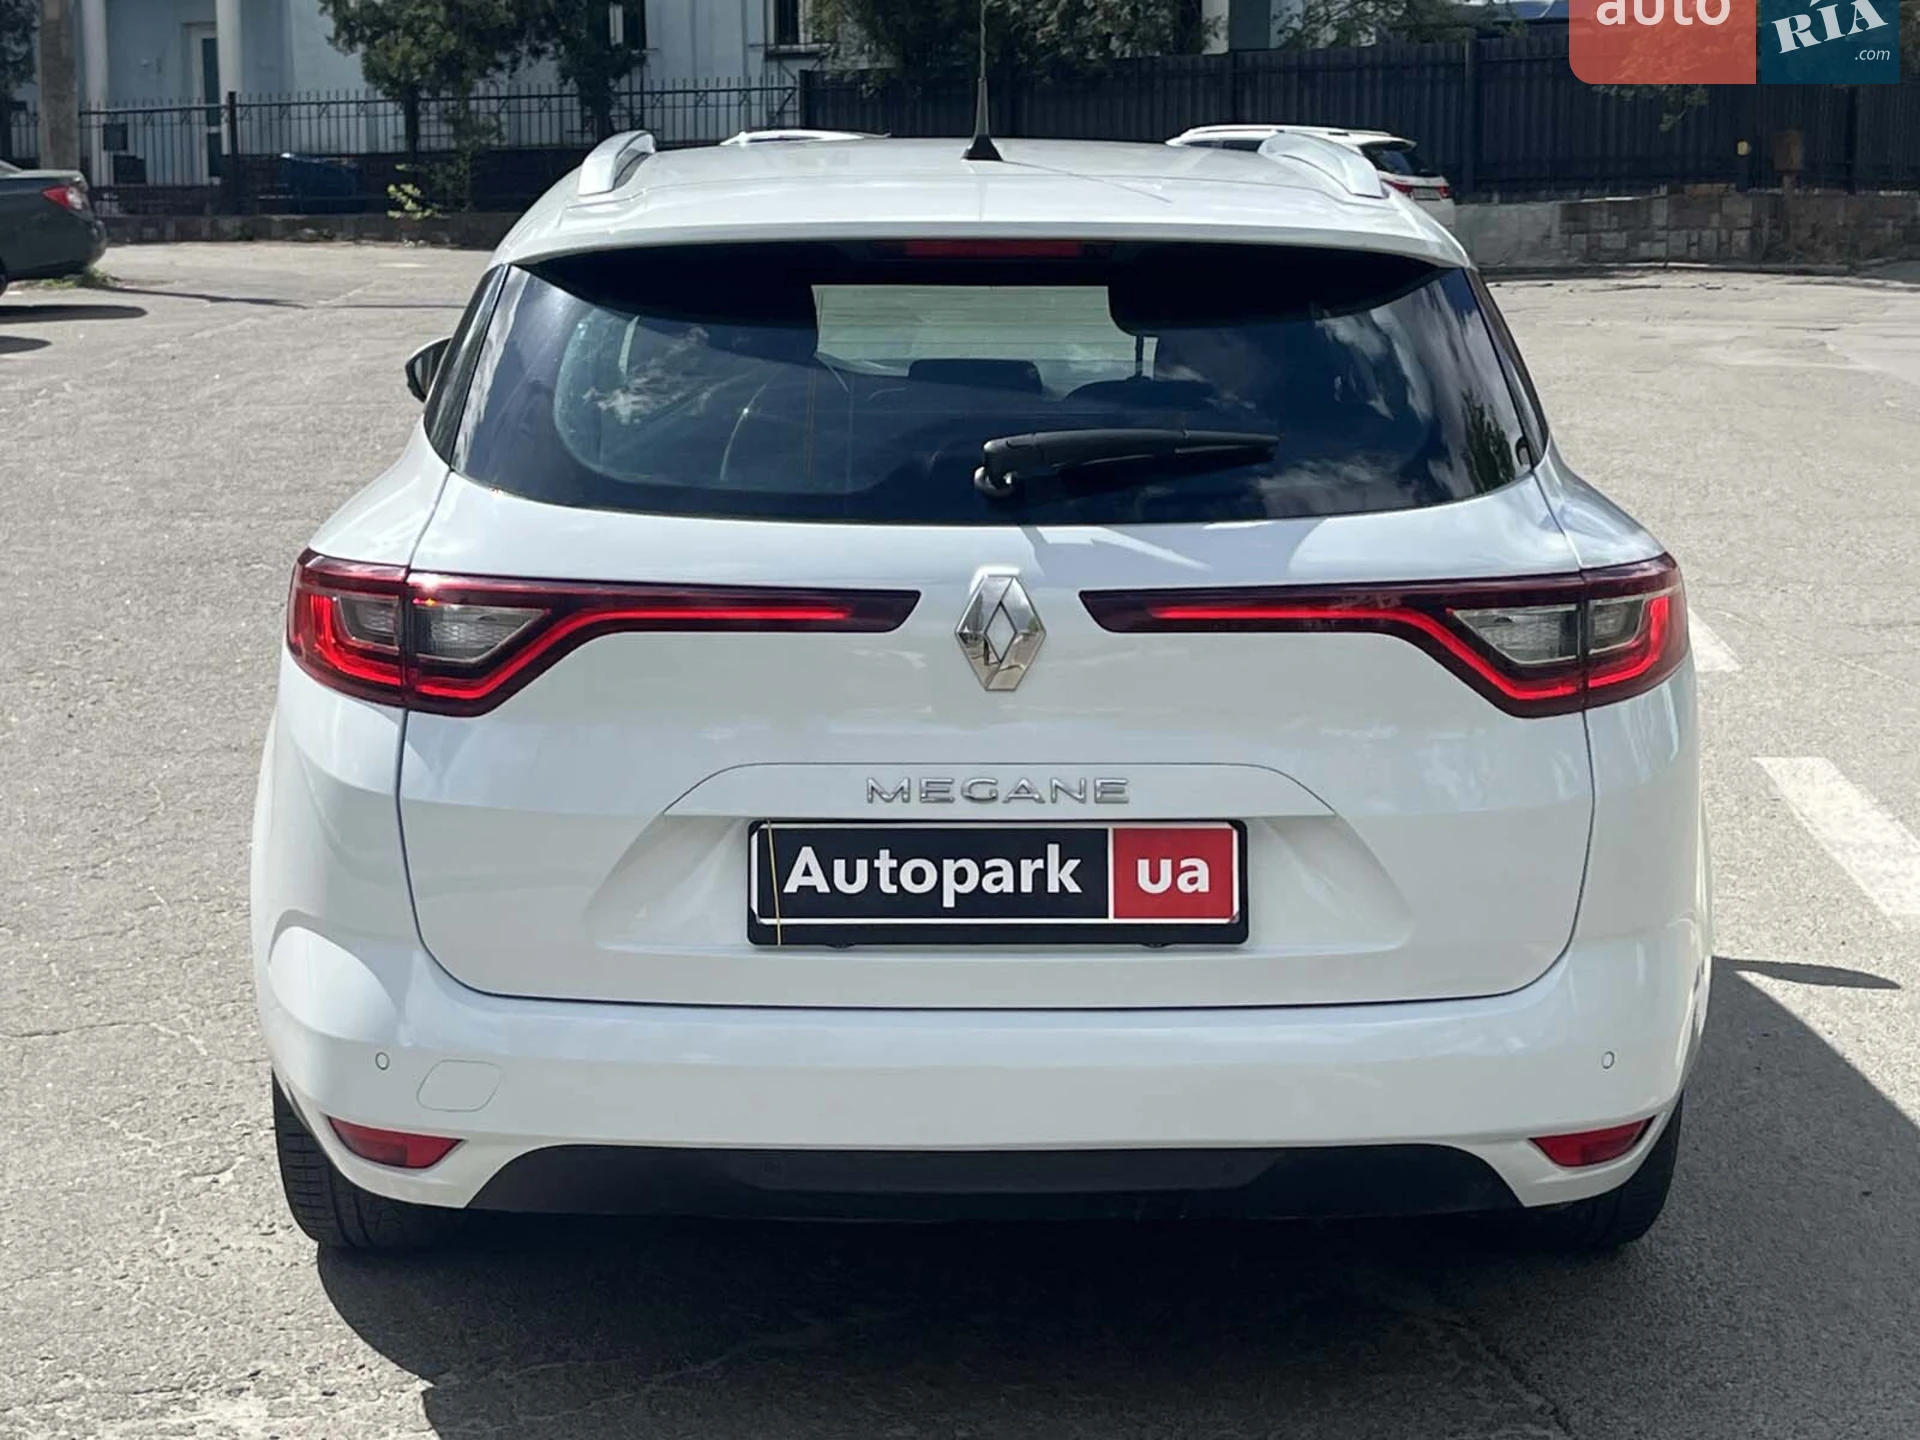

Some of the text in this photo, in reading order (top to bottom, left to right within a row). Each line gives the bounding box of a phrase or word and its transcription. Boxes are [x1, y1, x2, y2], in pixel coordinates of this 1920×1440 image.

[865, 776, 1131, 804] MEGANE
[783, 843, 1211, 908] Autopark ua
